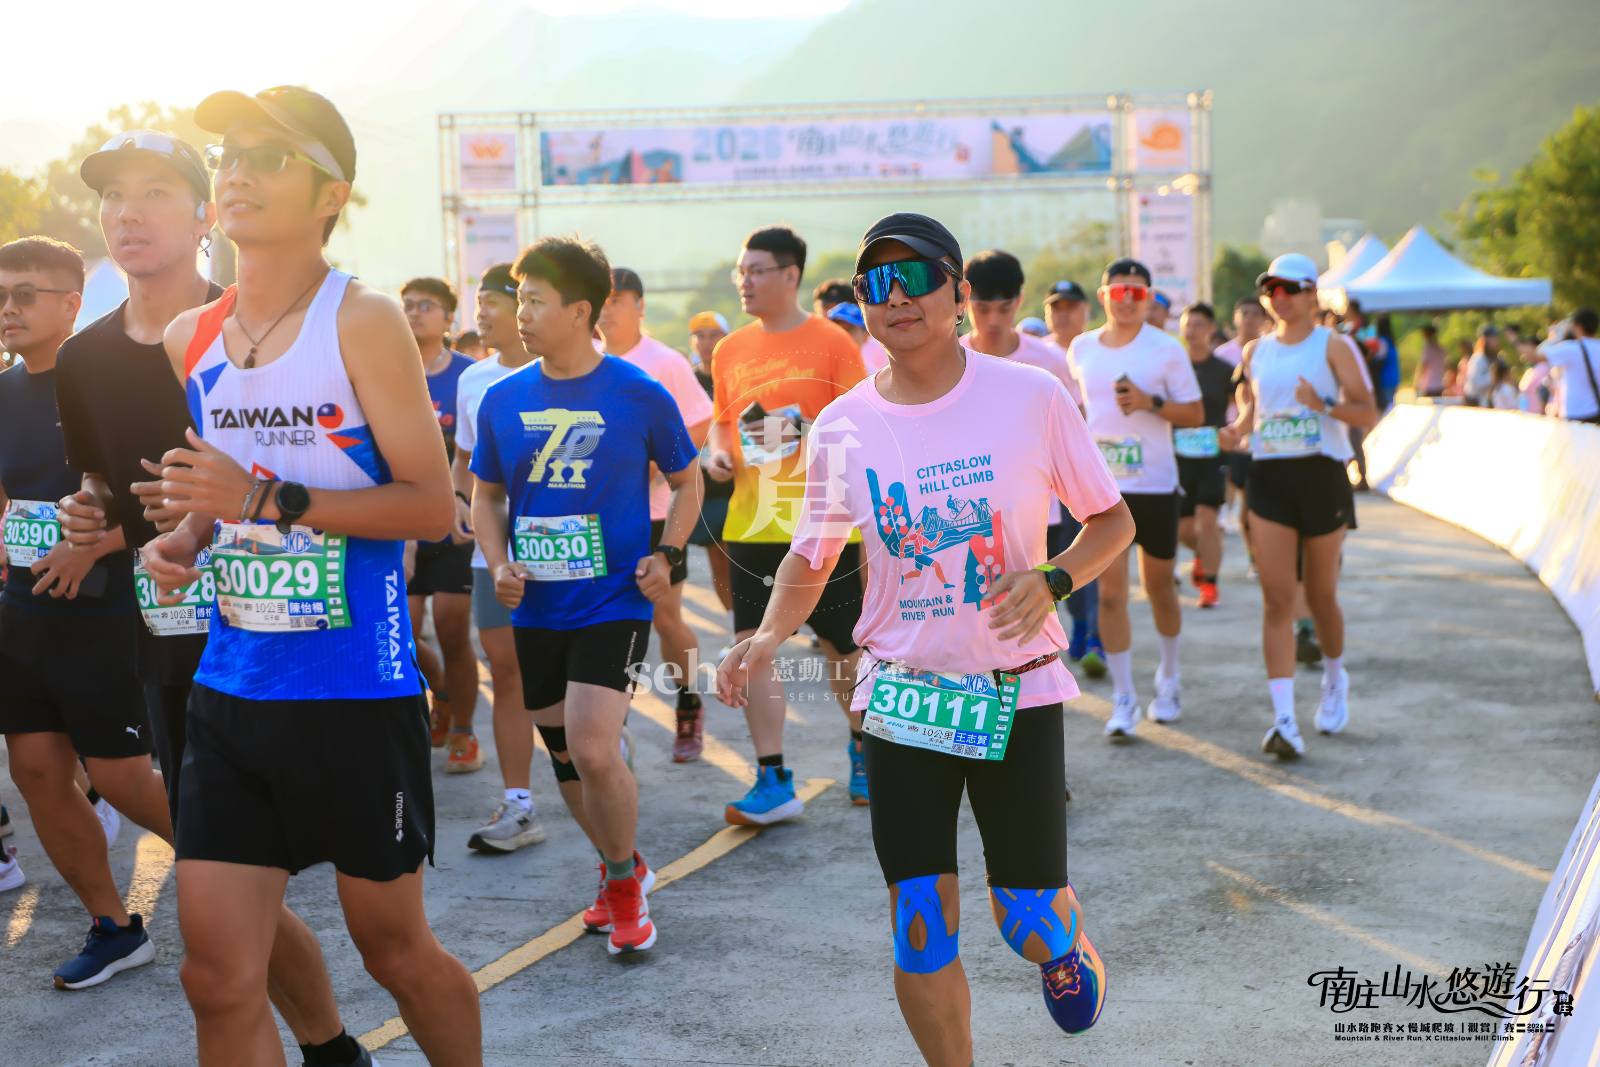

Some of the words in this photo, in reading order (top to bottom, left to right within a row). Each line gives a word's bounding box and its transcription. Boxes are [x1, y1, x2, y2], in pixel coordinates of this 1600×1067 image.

[210, 406, 314, 429] TAIWAN
[1263, 418, 1318, 438] 40049
[255, 430, 317, 446] RUNNER
[916, 454, 992, 480] CITTASLOW
[919, 480, 950, 495] HILL
[952, 470, 994, 488] CLIMB
[4, 521, 58, 547] 30390
[518, 535, 588, 560] 30030
[214, 558, 319, 597] 30029
[900, 595, 943, 609] MOUNTAIN
[945, 594, 953, 604] &
[170, 608, 195, 620] 10公里
[385, 569, 404, 680] TAIWAN
[901, 611, 926, 621] RIVER
[932, 607, 955, 618] RUN
[374, 621, 392, 683] RUNNER
[961, 674, 990, 693] JKCR
[873, 683, 988, 730] 30111
[921, 727, 953, 741] 10公里
[956, 732, 988, 746] 王志賢
